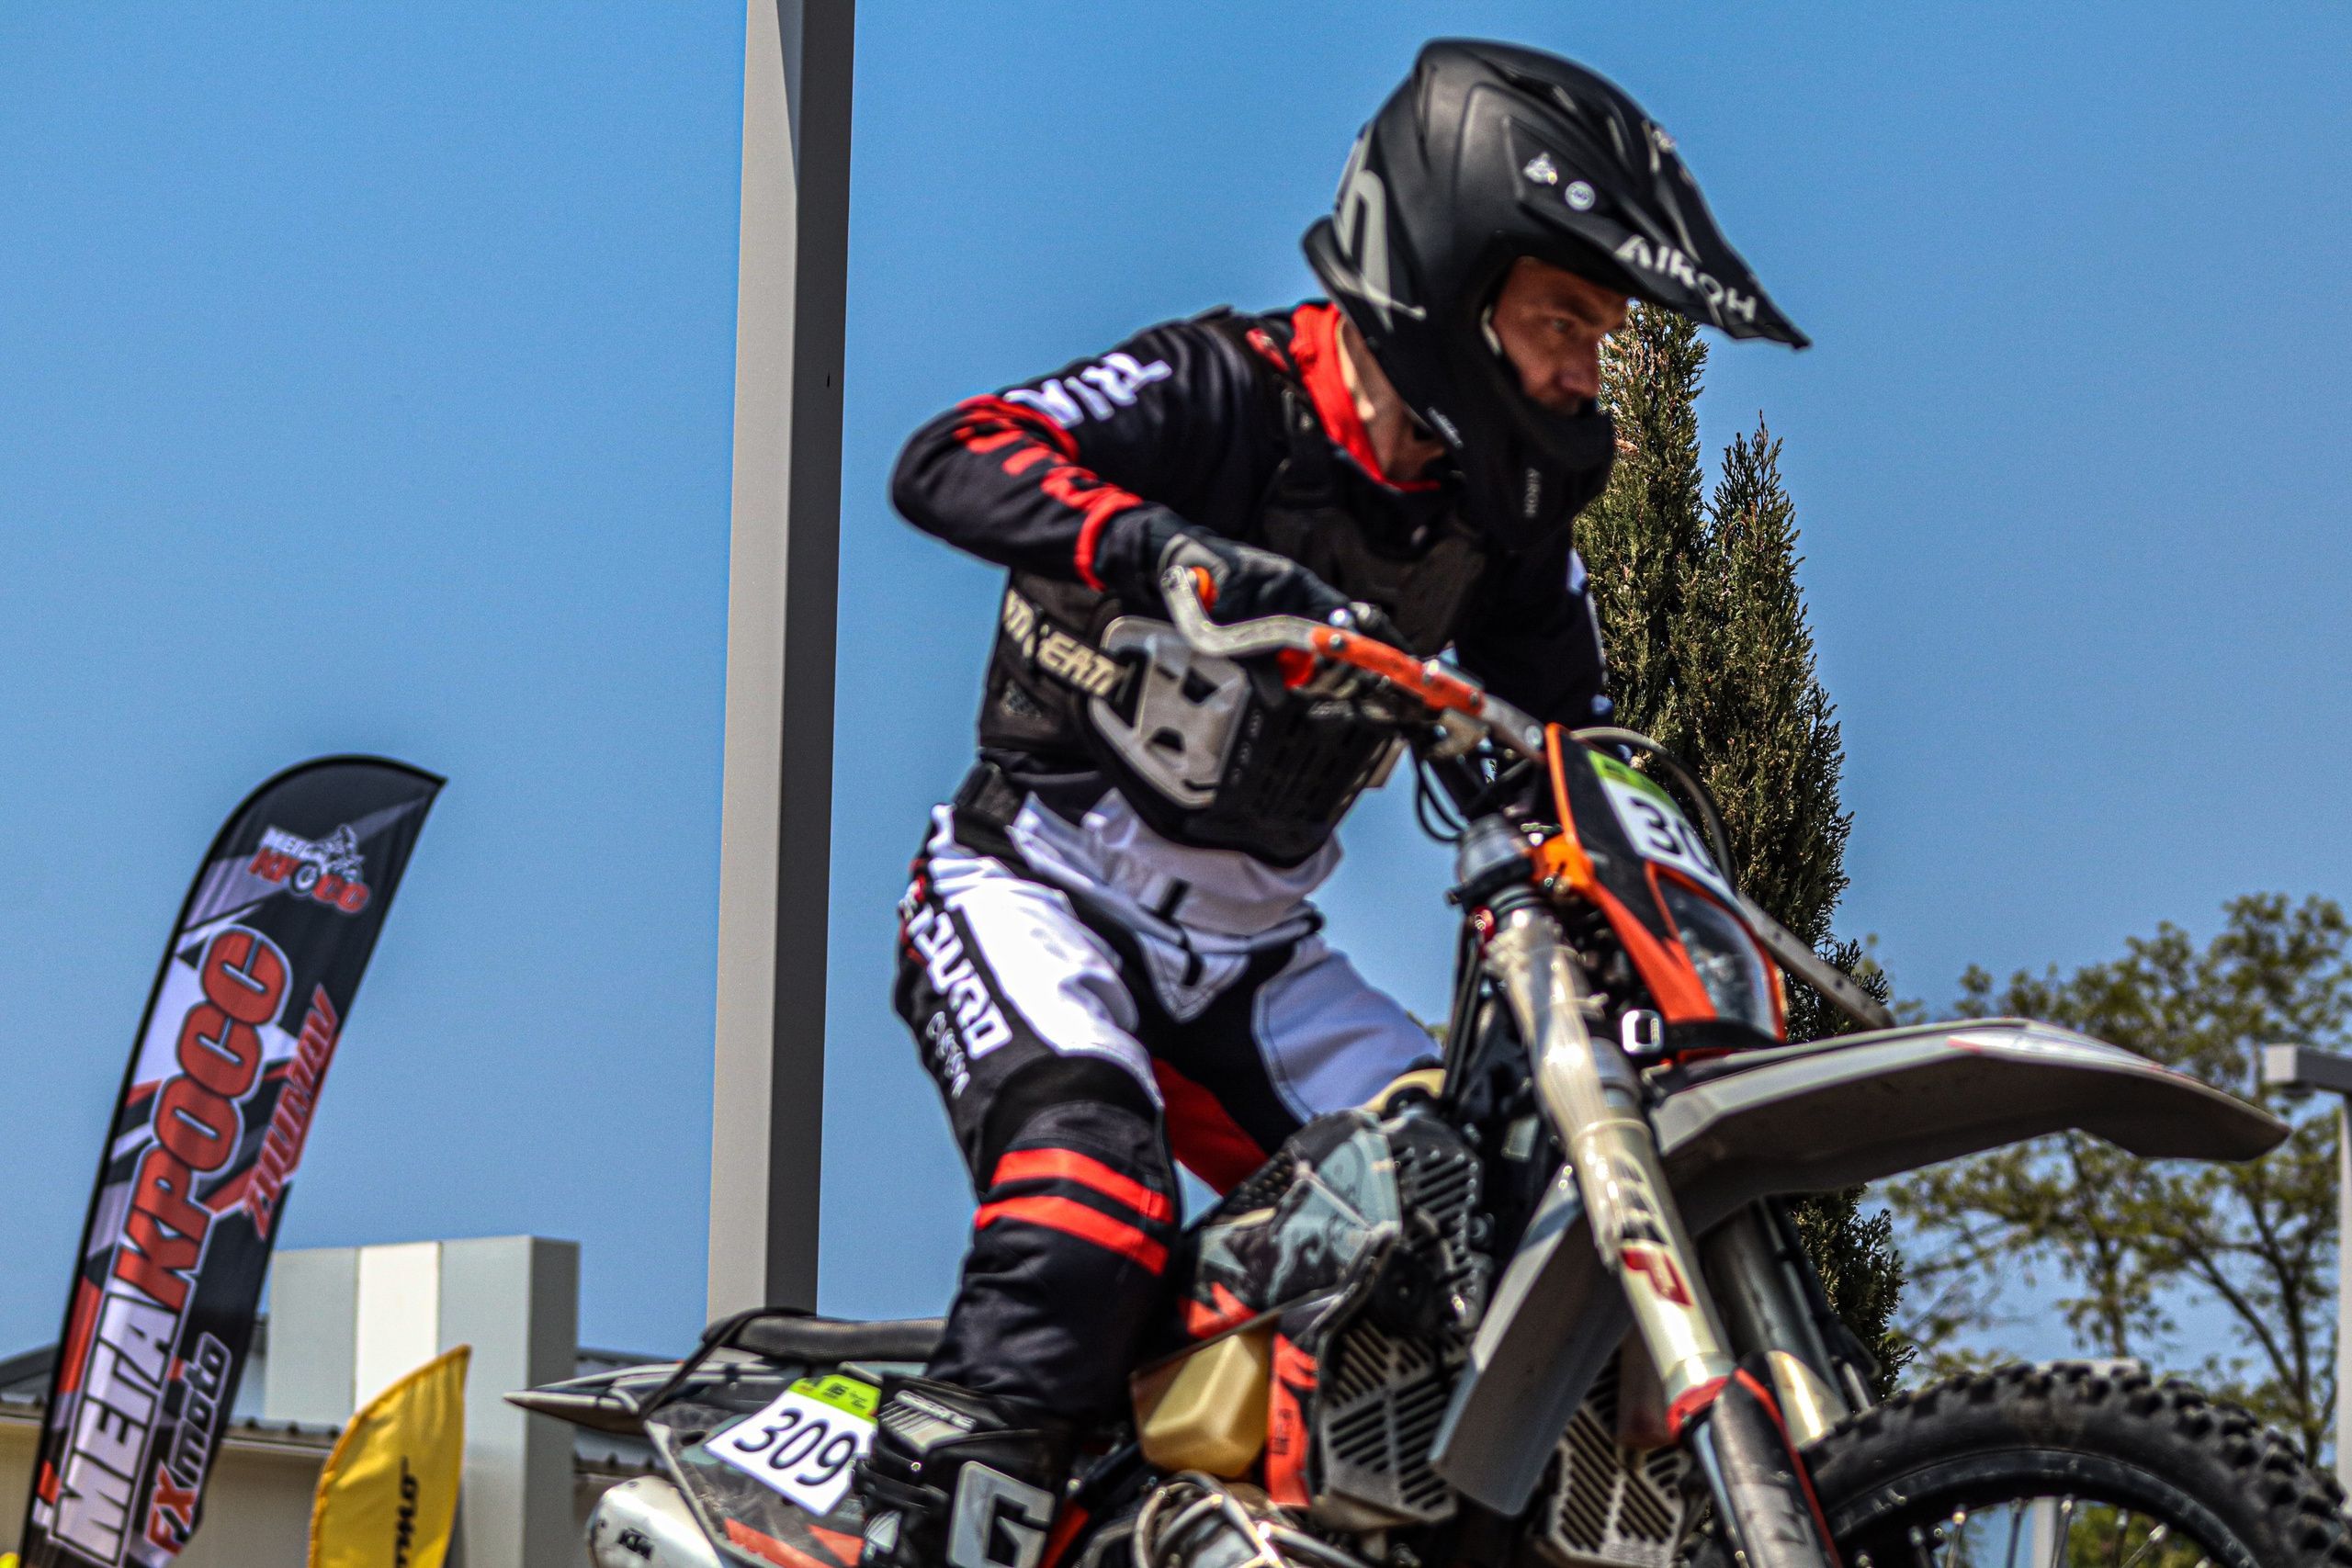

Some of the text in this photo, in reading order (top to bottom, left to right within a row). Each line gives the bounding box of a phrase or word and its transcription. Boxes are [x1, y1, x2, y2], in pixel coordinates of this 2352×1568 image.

[1613, 233, 1758, 321] AIROH
[733, 1407, 859, 1487] 309
[616, 1527, 655, 1562] KTM
